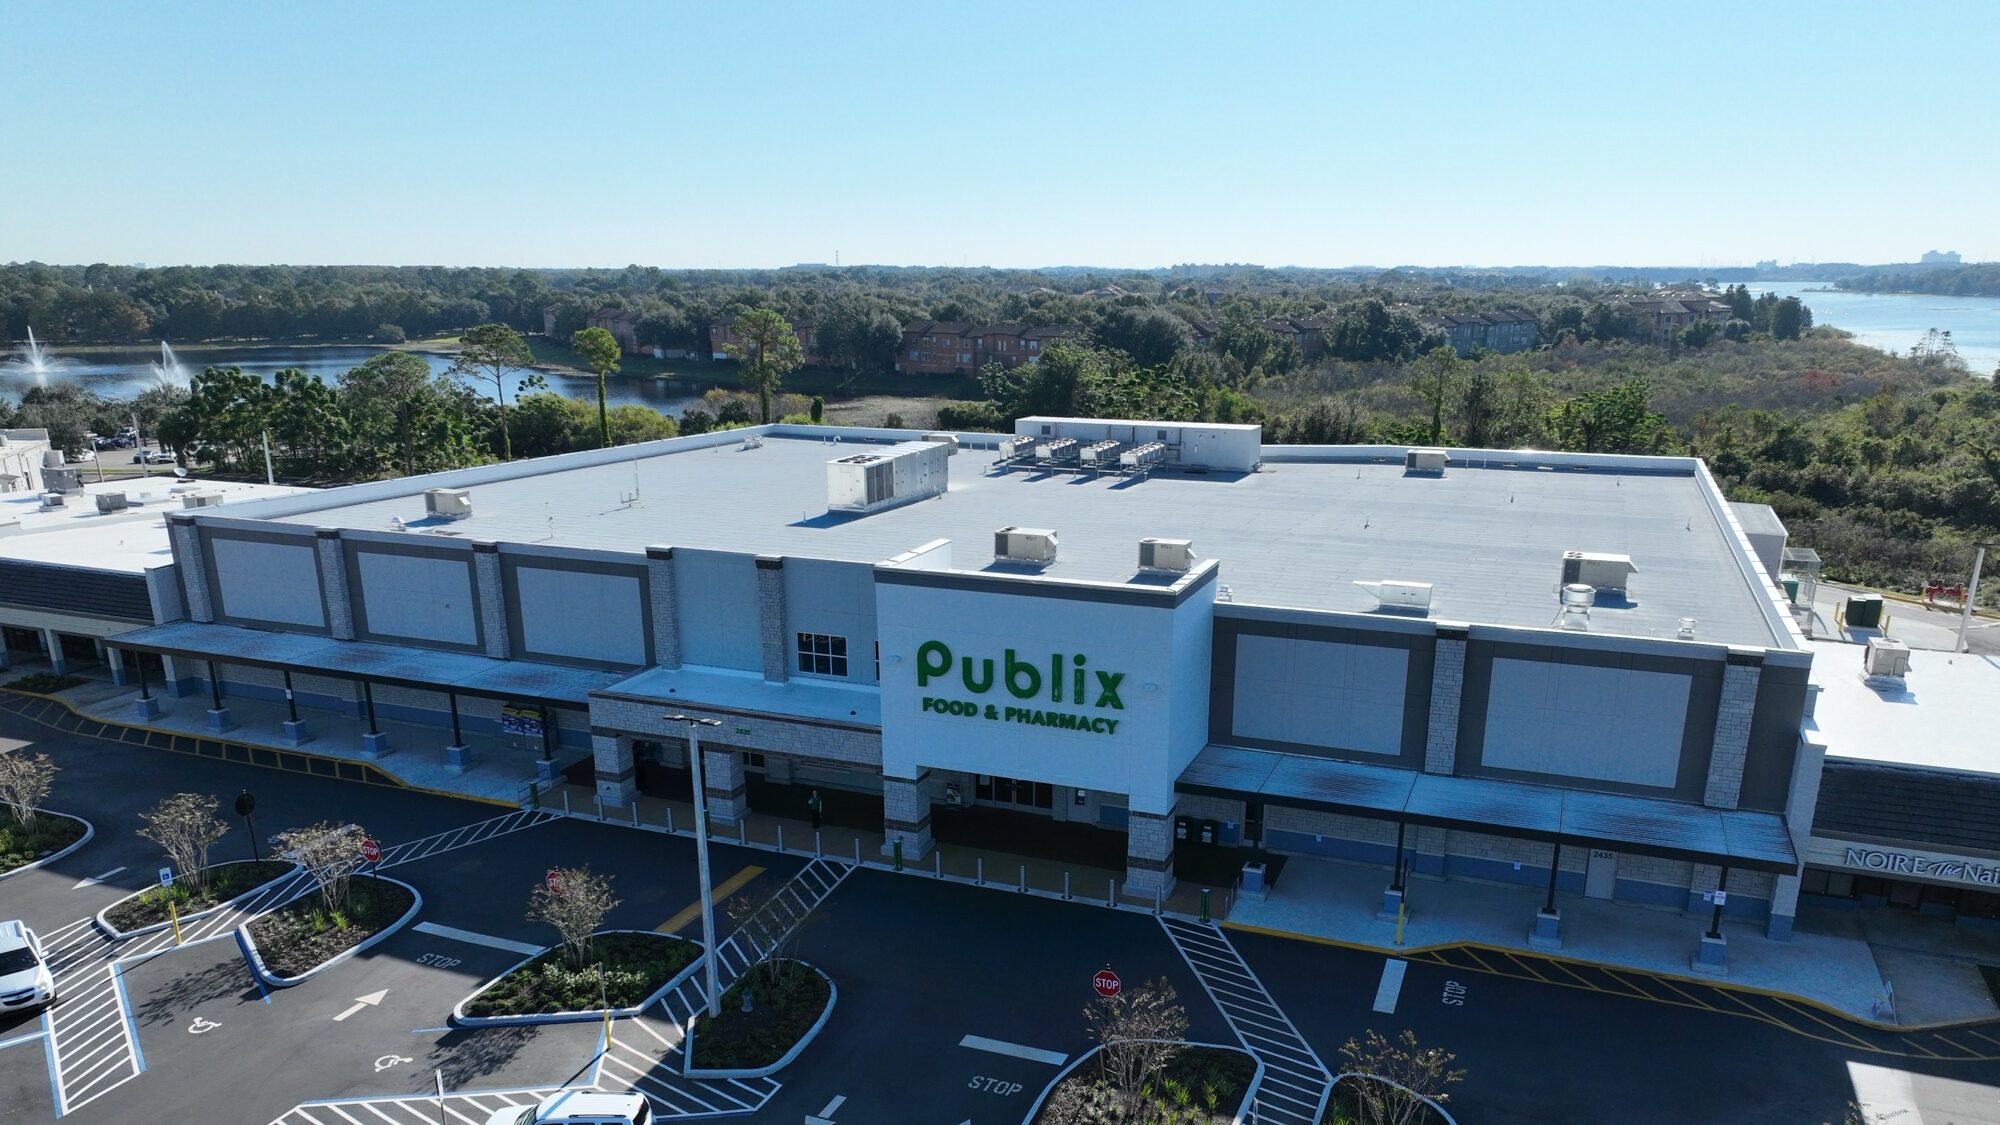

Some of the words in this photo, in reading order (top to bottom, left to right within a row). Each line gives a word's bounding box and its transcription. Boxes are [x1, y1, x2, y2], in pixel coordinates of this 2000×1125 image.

[917, 640, 1125, 710] Publix
[922, 697, 978, 717] FOOD
[984, 704, 999, 720] &
[1005, 706, 1119, 734] PHARMACY
[363, 846, 378, 856] STOP
[1593, 851, 1613, 860] 2435
[1845, 849, 1926, 874] NOIRE
[1927, 861, 1962, 876] The
[416, 953, 461, 968] STOP
[1095, 977, 1119, 990] STOP
[1441, 980, 1467, 1006] STOP
[967, 1075, 1023, 1096] STOP
